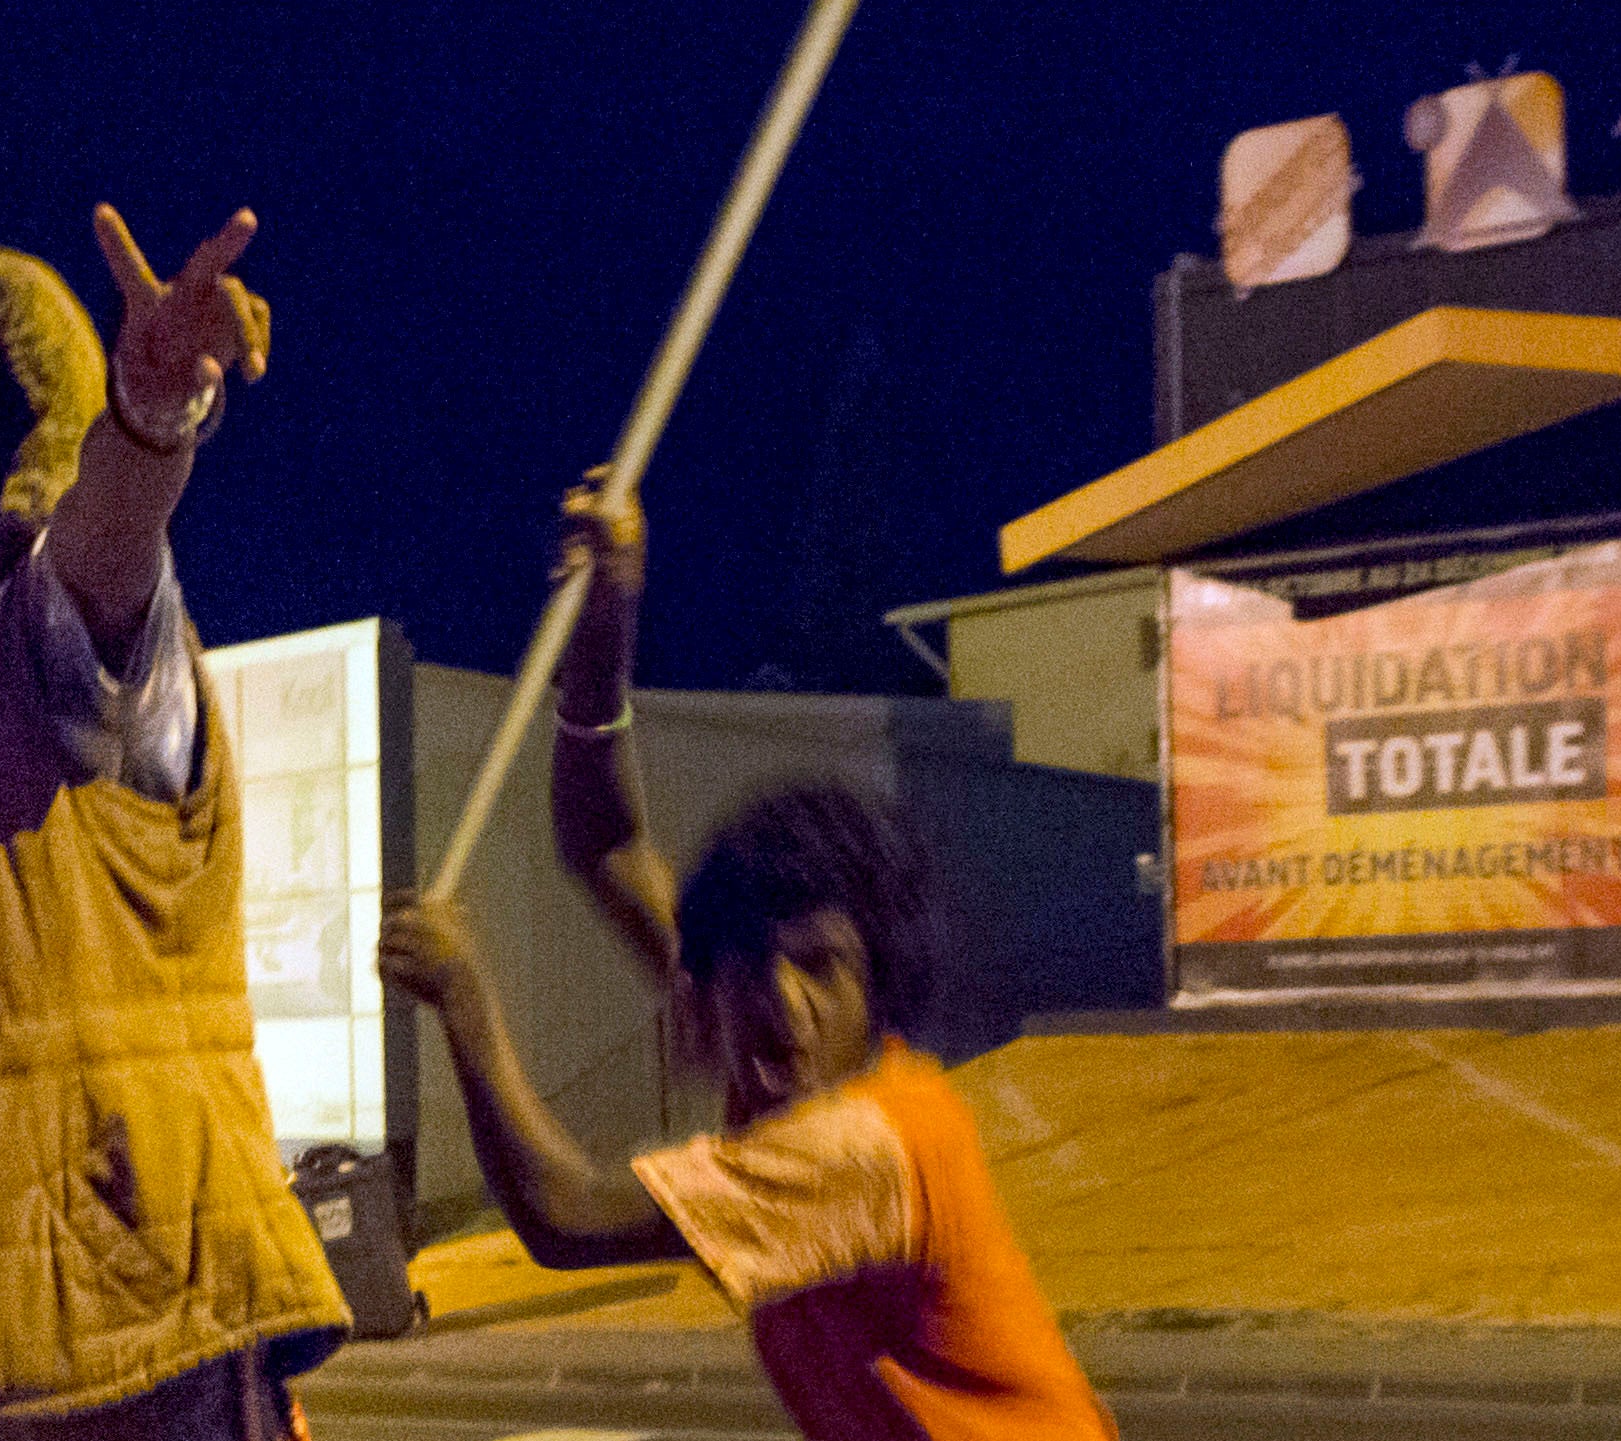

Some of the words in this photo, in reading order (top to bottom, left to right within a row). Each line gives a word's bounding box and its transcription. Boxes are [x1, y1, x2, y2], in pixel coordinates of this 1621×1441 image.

[1220, 630, 1606, 723] LIQUIDATION
[1336, 721, 1586, 799] TOTALE
[1203, 852, 1312, 892] AVANT
